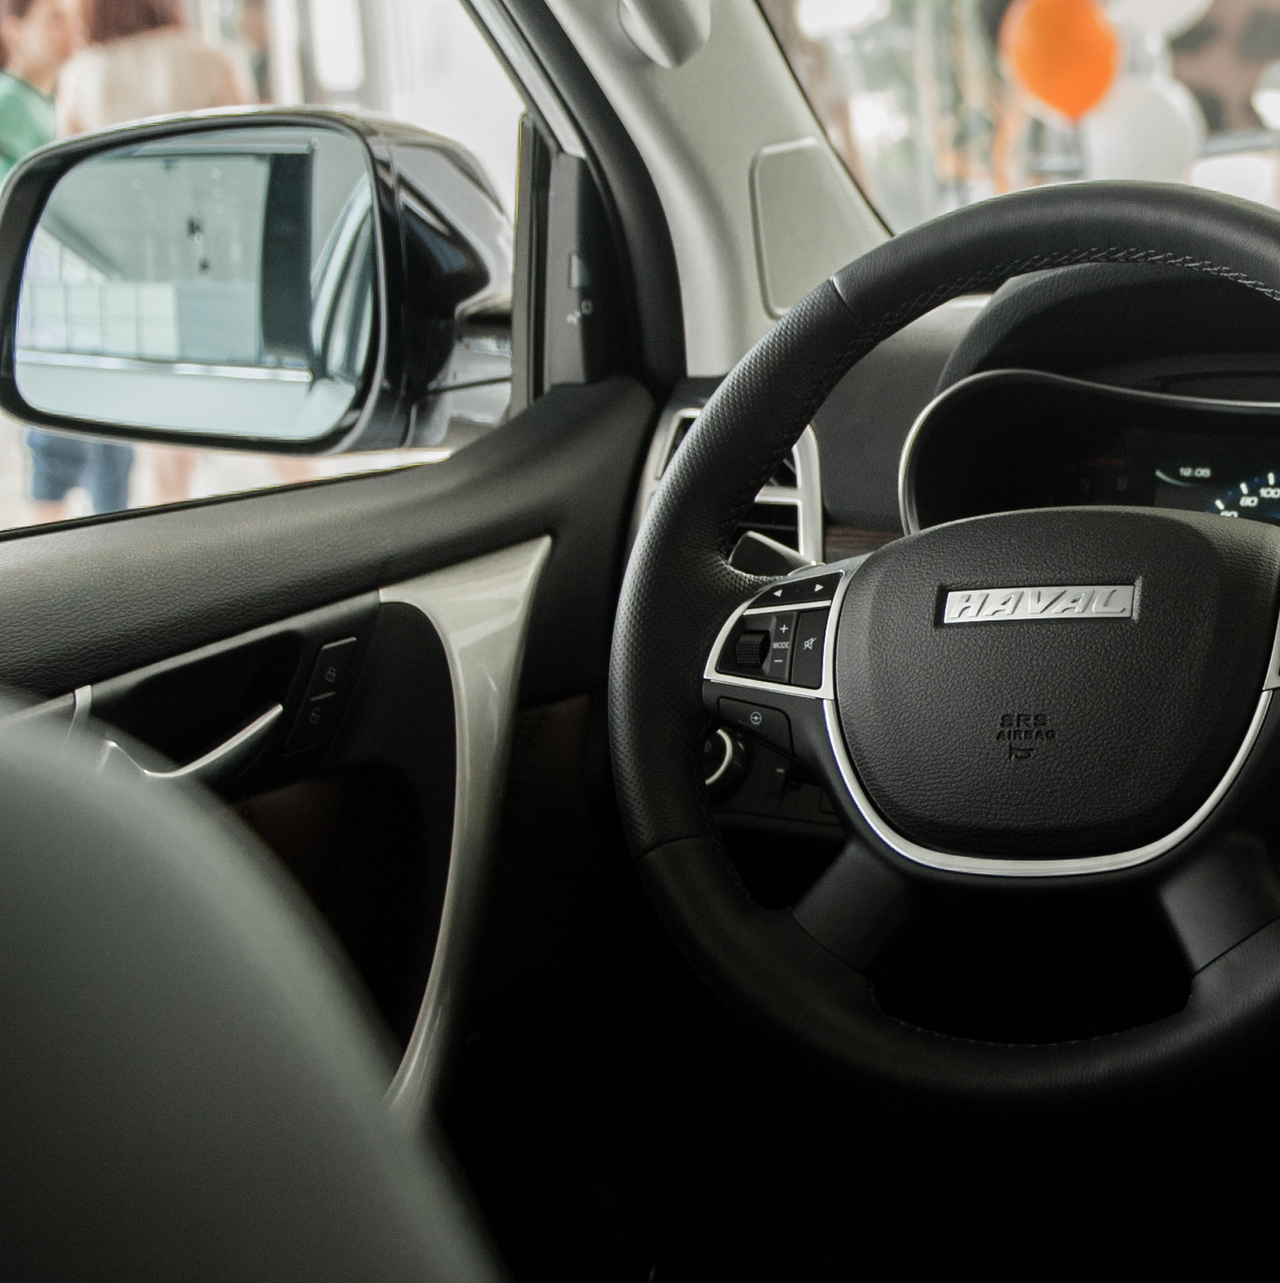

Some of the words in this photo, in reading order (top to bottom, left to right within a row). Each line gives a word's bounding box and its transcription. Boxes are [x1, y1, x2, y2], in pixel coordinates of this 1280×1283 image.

[949, 589, 1126, 618] HAVAL
[999, 713, 1050, 727] SRS
[996, 729, 1057, 741] AIRBAG
